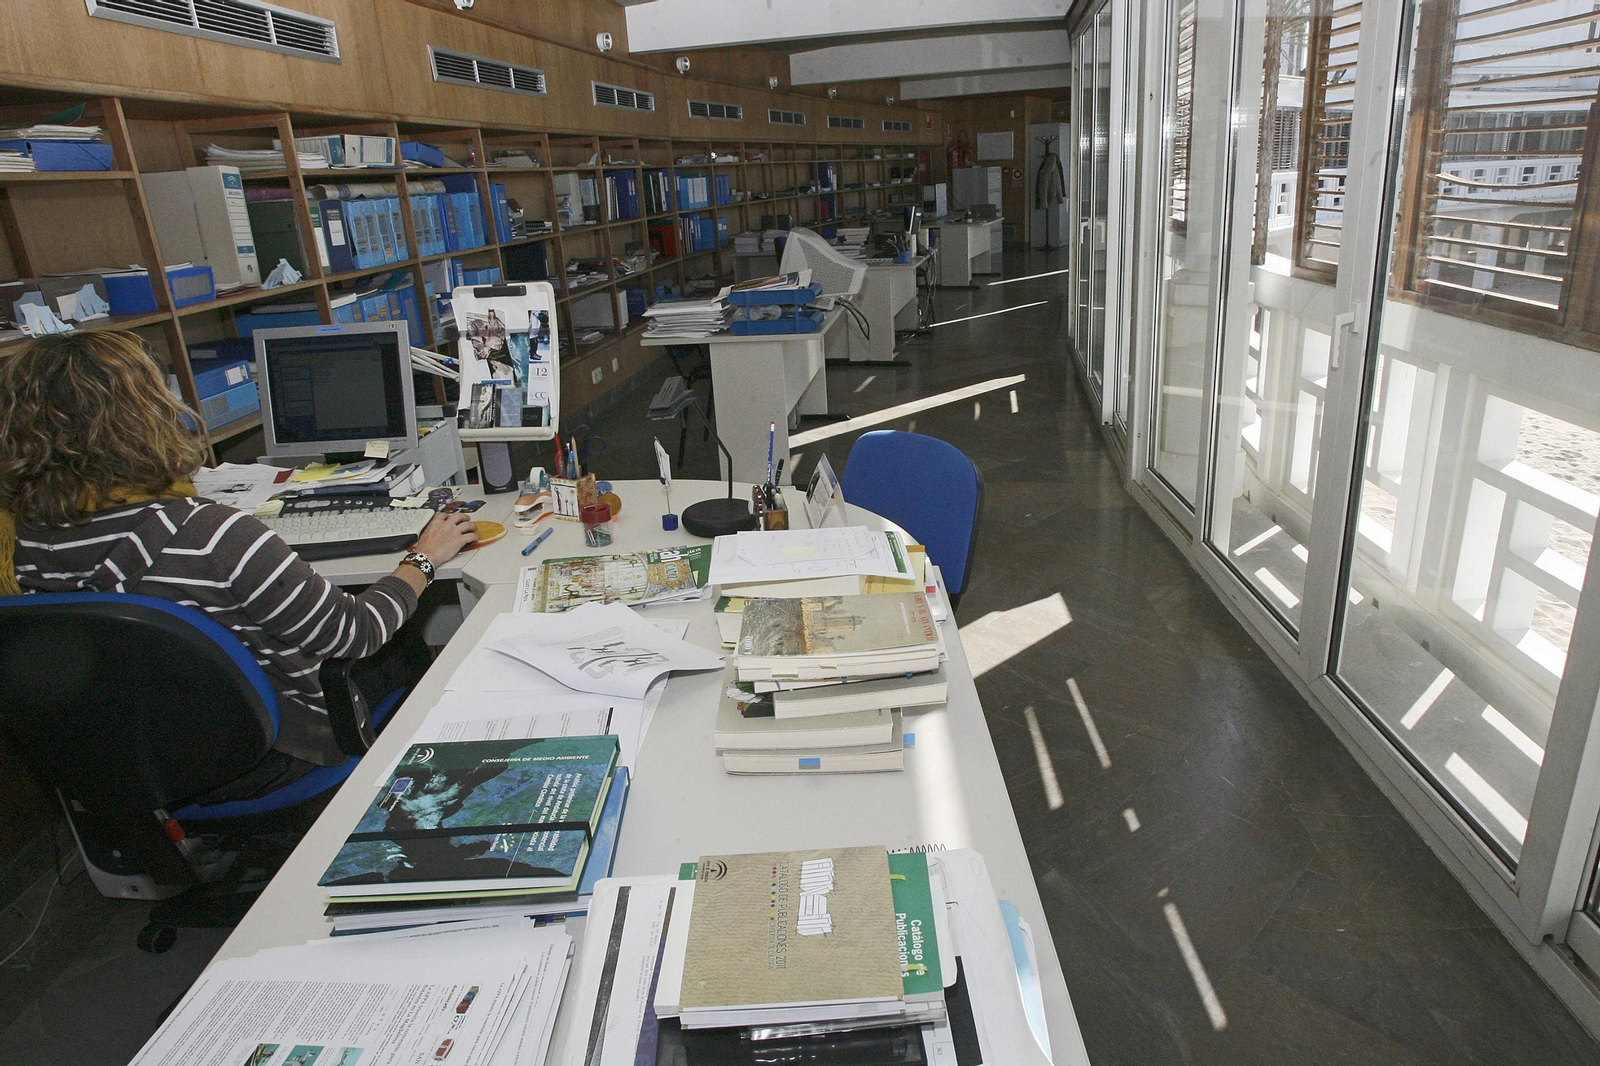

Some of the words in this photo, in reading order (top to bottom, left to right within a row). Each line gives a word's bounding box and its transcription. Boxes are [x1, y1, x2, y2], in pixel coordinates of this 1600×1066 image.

[559, 784, 568, 794] costa
[545, 795, 554, 806] nivel
[895, 913, 910, 977] Publicacions
[911, 920, 924, 961] Catálogo
[775, 955, 786, 969] 2011
